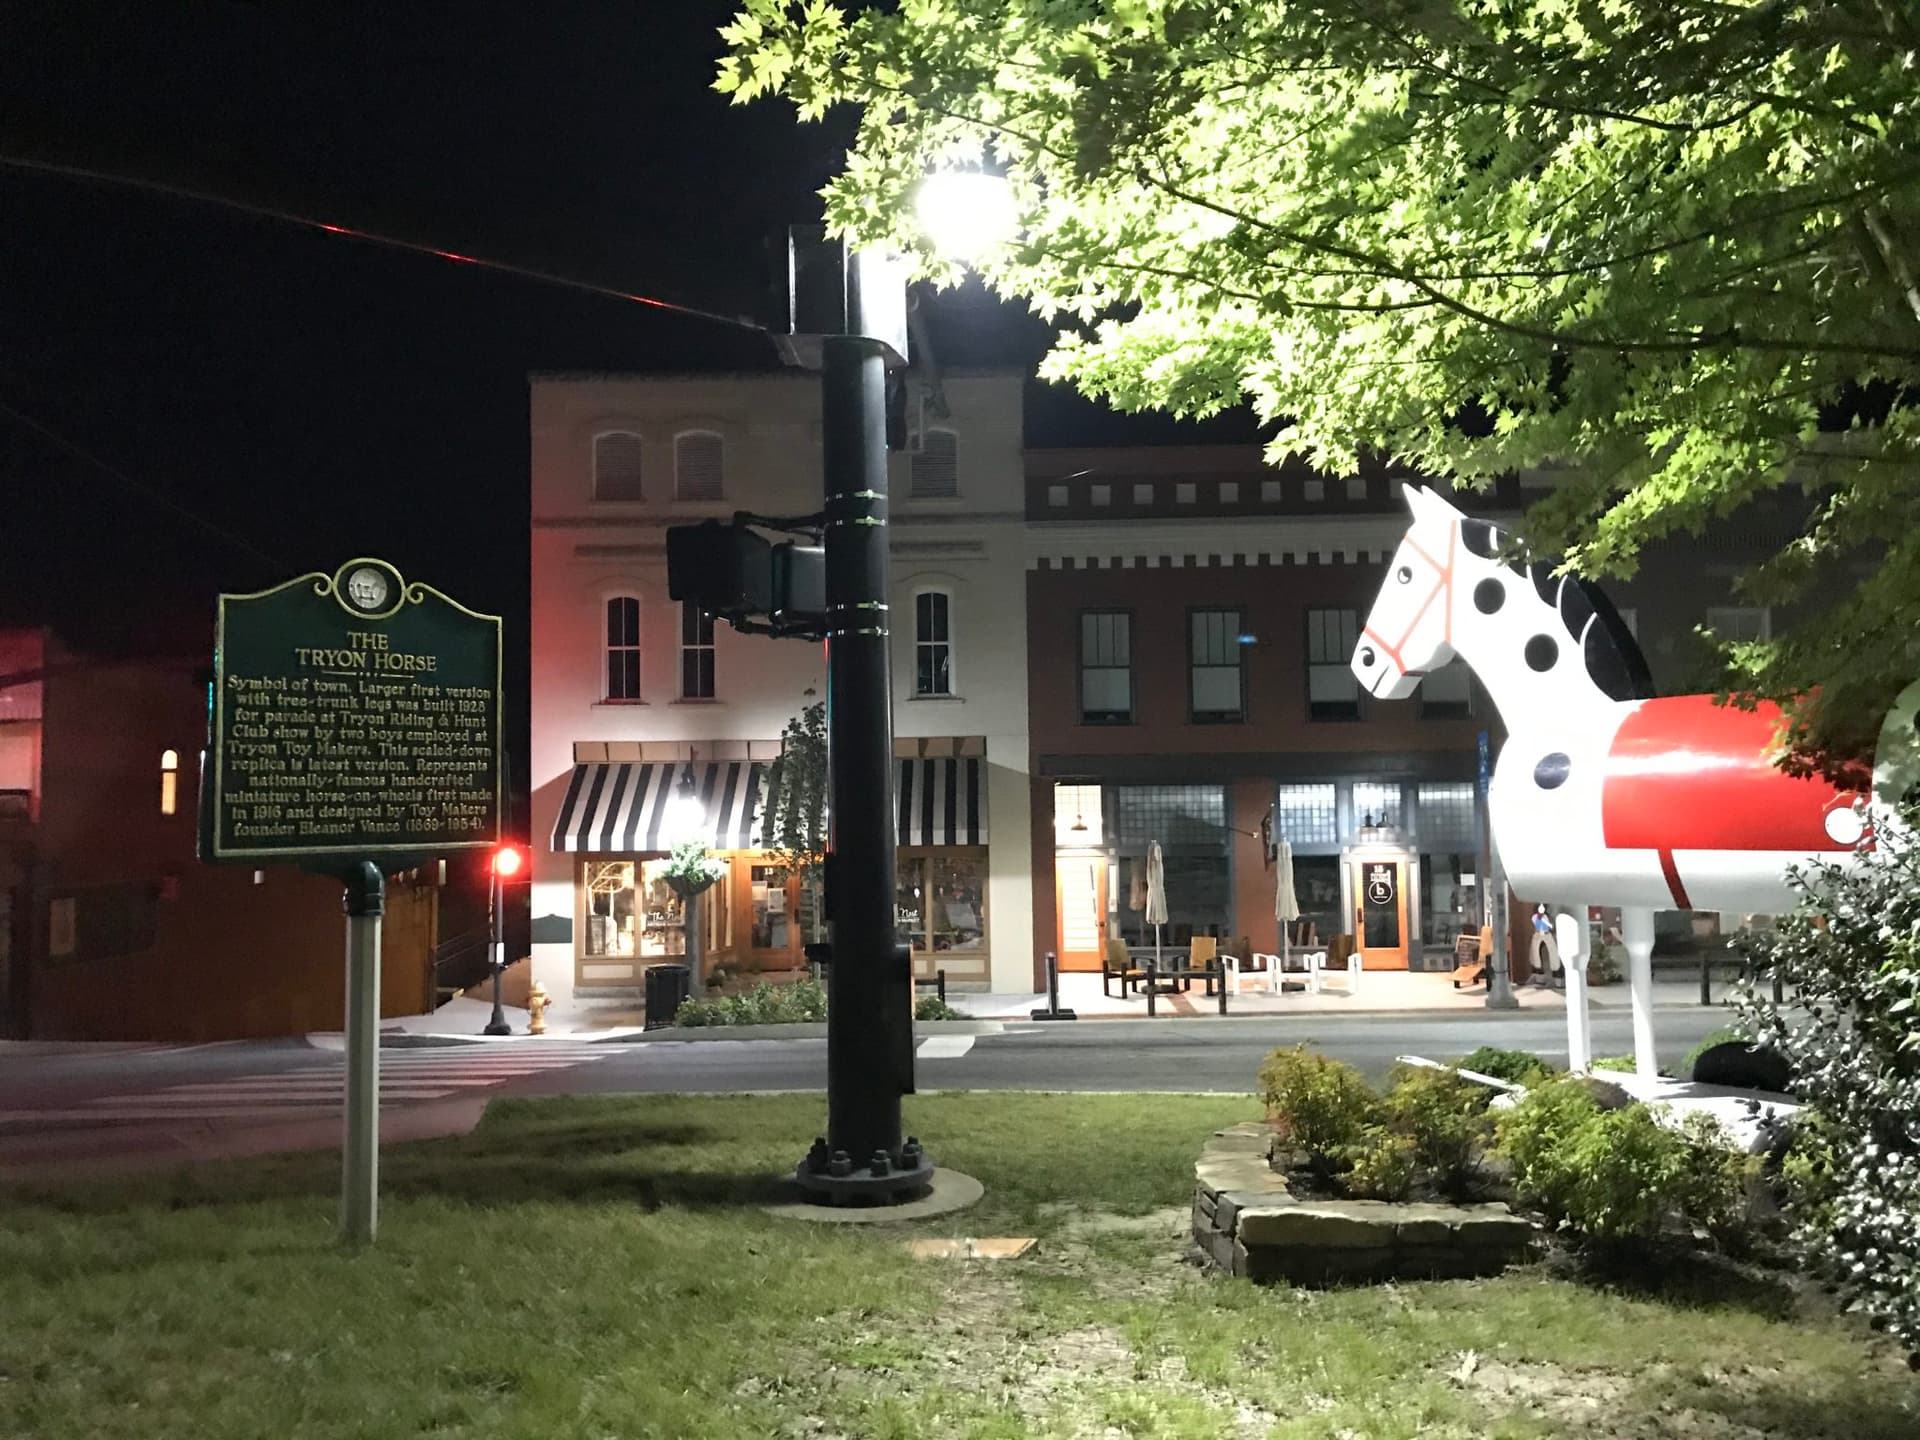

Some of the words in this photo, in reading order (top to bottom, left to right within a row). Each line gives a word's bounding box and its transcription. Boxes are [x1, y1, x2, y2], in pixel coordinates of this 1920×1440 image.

[346, 631, 389, 651] THE
[294, 647, 367, 669] TRYON
[374, 652, 438, 672] HORSE
[227, 674, 288, 691] Symbol
[291, 677, 310, 692] of
[313, 679, 352, 693] town.
[359, 680, 407, 698] Larger
[410, 683, 441, 697] first
[445, 686, 491, 699] version
[235, 692, 271, 706] with
[276, 693, 360, 710] tree-trunk
[364, 696, 392, 713] legs
[395, 699, 420, 711] was
[423, 698, 456, 713] built
[458, 699, 487, 714] 1928
[234, 707, 260, 721] for
[264, 709, 317, 725] parade
[320, 710, 337, 723] at
[339, 710, 385, 727] Tryon
[390, 712, 434, 729] Riding
[439, 713, 450, 727] &
[453, 713, 487, 728] Hunt
[231, 723, 270, 738] Club
[272, 724, 310, 739] show
[313, 725, 335, 742] by
[338, 726, 366, 740] two
[368, 727, 404, 743] boys
[406, 729, 470, 745] employed
[474, 729, 488, 742] at
[226, 739, 278, 757] Tryon
[282, 740, 312, 757] Toy
[316, 741, 371, 756] Makers.
[377, 742, 409, 757] This
[411, 743, 492, 758] scaled-down
[231, 757, 286, 774] replica
[291, 757, 303, 771] is
[308, 758, 351, 771] latest
[355, 758, 410, 772] version.
[415, 758, 489, 775] Represents
[247, 772, 386, 789] nationally-famous
[390, 773, 474, 787] handcrafted
[224, 789, 301, 804] miniature
[305, 788, 423, 803] horse-on-wheels
[426, 788, 457, 802] first
[460, 787, 494, 801] made
[231, 806, 248, 820] in
[253, 804, 283, 820] 1916
[286, 804, 315, 819] and
[318, 803, 381, 820] designed
[386, 802, 406, 819] by
[408, 803, 437, 818] Toy
[441, 801, 488, 816] Makers
[233, 821, 297, 836] founder
[299, 820, 356, 835] Eleanor
[359, 818, 401, 833] Vance
